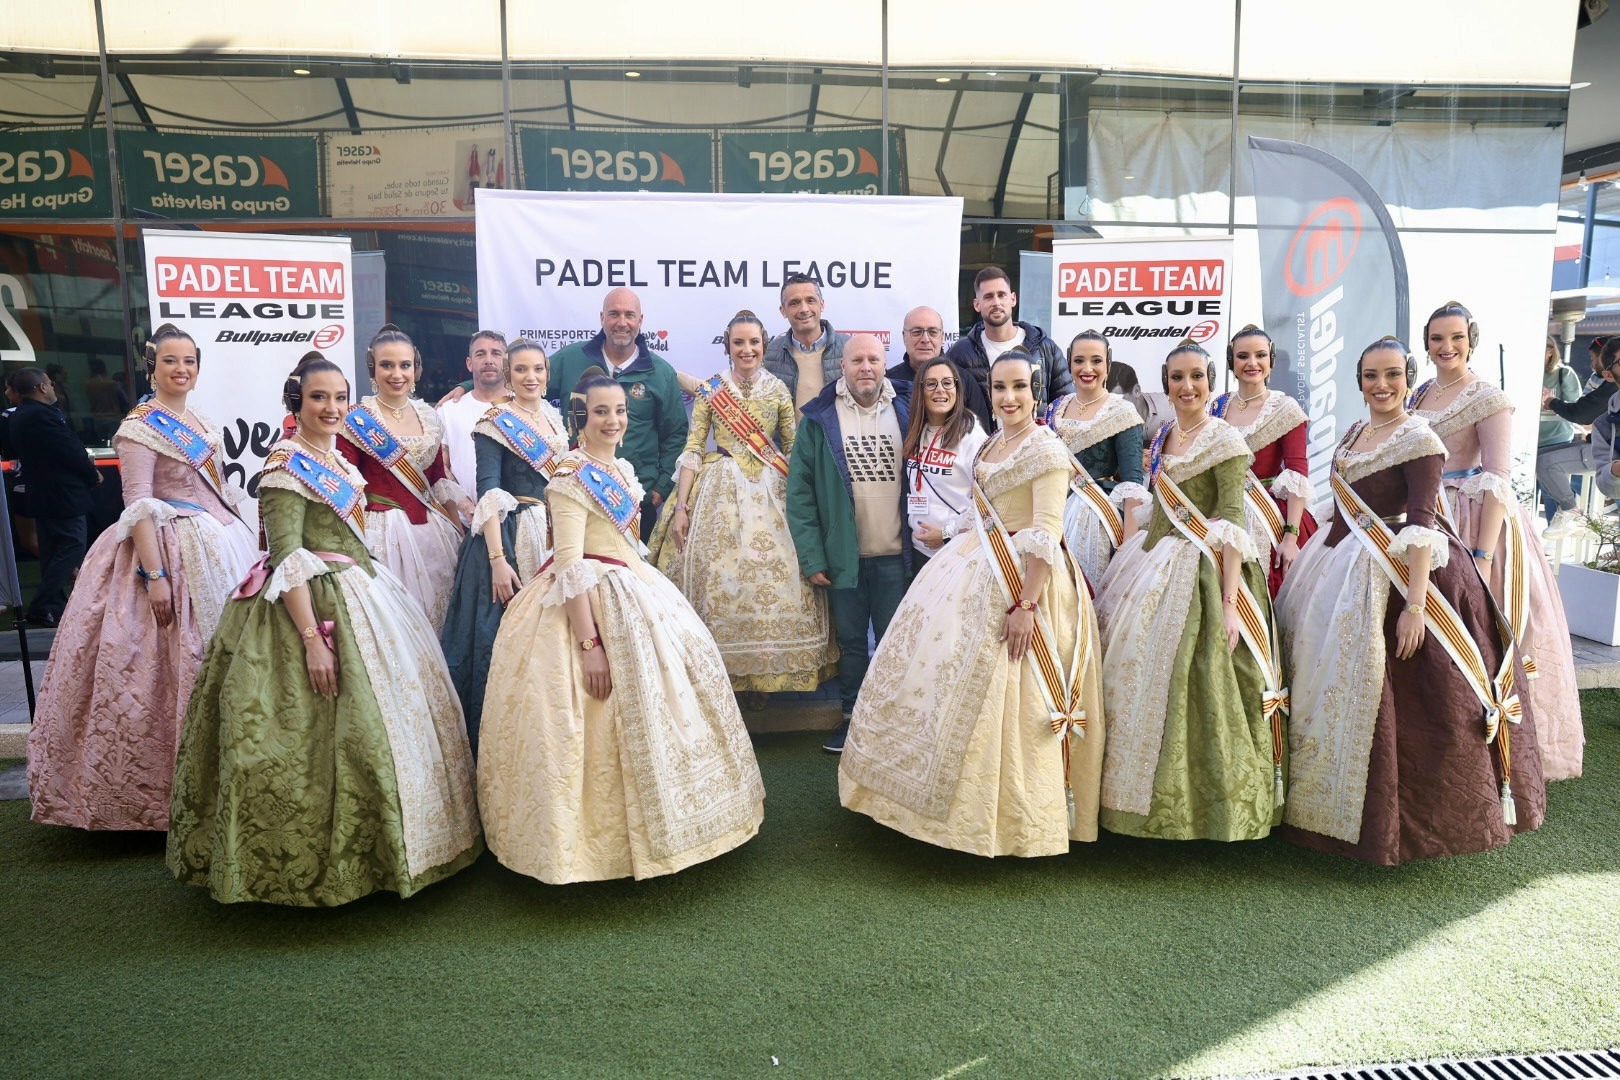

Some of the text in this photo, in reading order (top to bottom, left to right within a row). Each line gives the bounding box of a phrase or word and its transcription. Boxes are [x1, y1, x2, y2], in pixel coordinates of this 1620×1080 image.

[157, 263, 342, 294] PADEL TEAM
[535, 258, 892, 289] PADEL TEAM LEAGUE
[1060, 265, 1222, 292] PADEL TEAM
[159, 302, 345, 320] LEAGUE
[1058, 300, 1221, 316] LEAGUE
[215, 330, 316, 346] Bullpadel
[520, 329, 597, 339] PRIMESPORTS
[1101, 326, 1191, 340] Bullpadel
